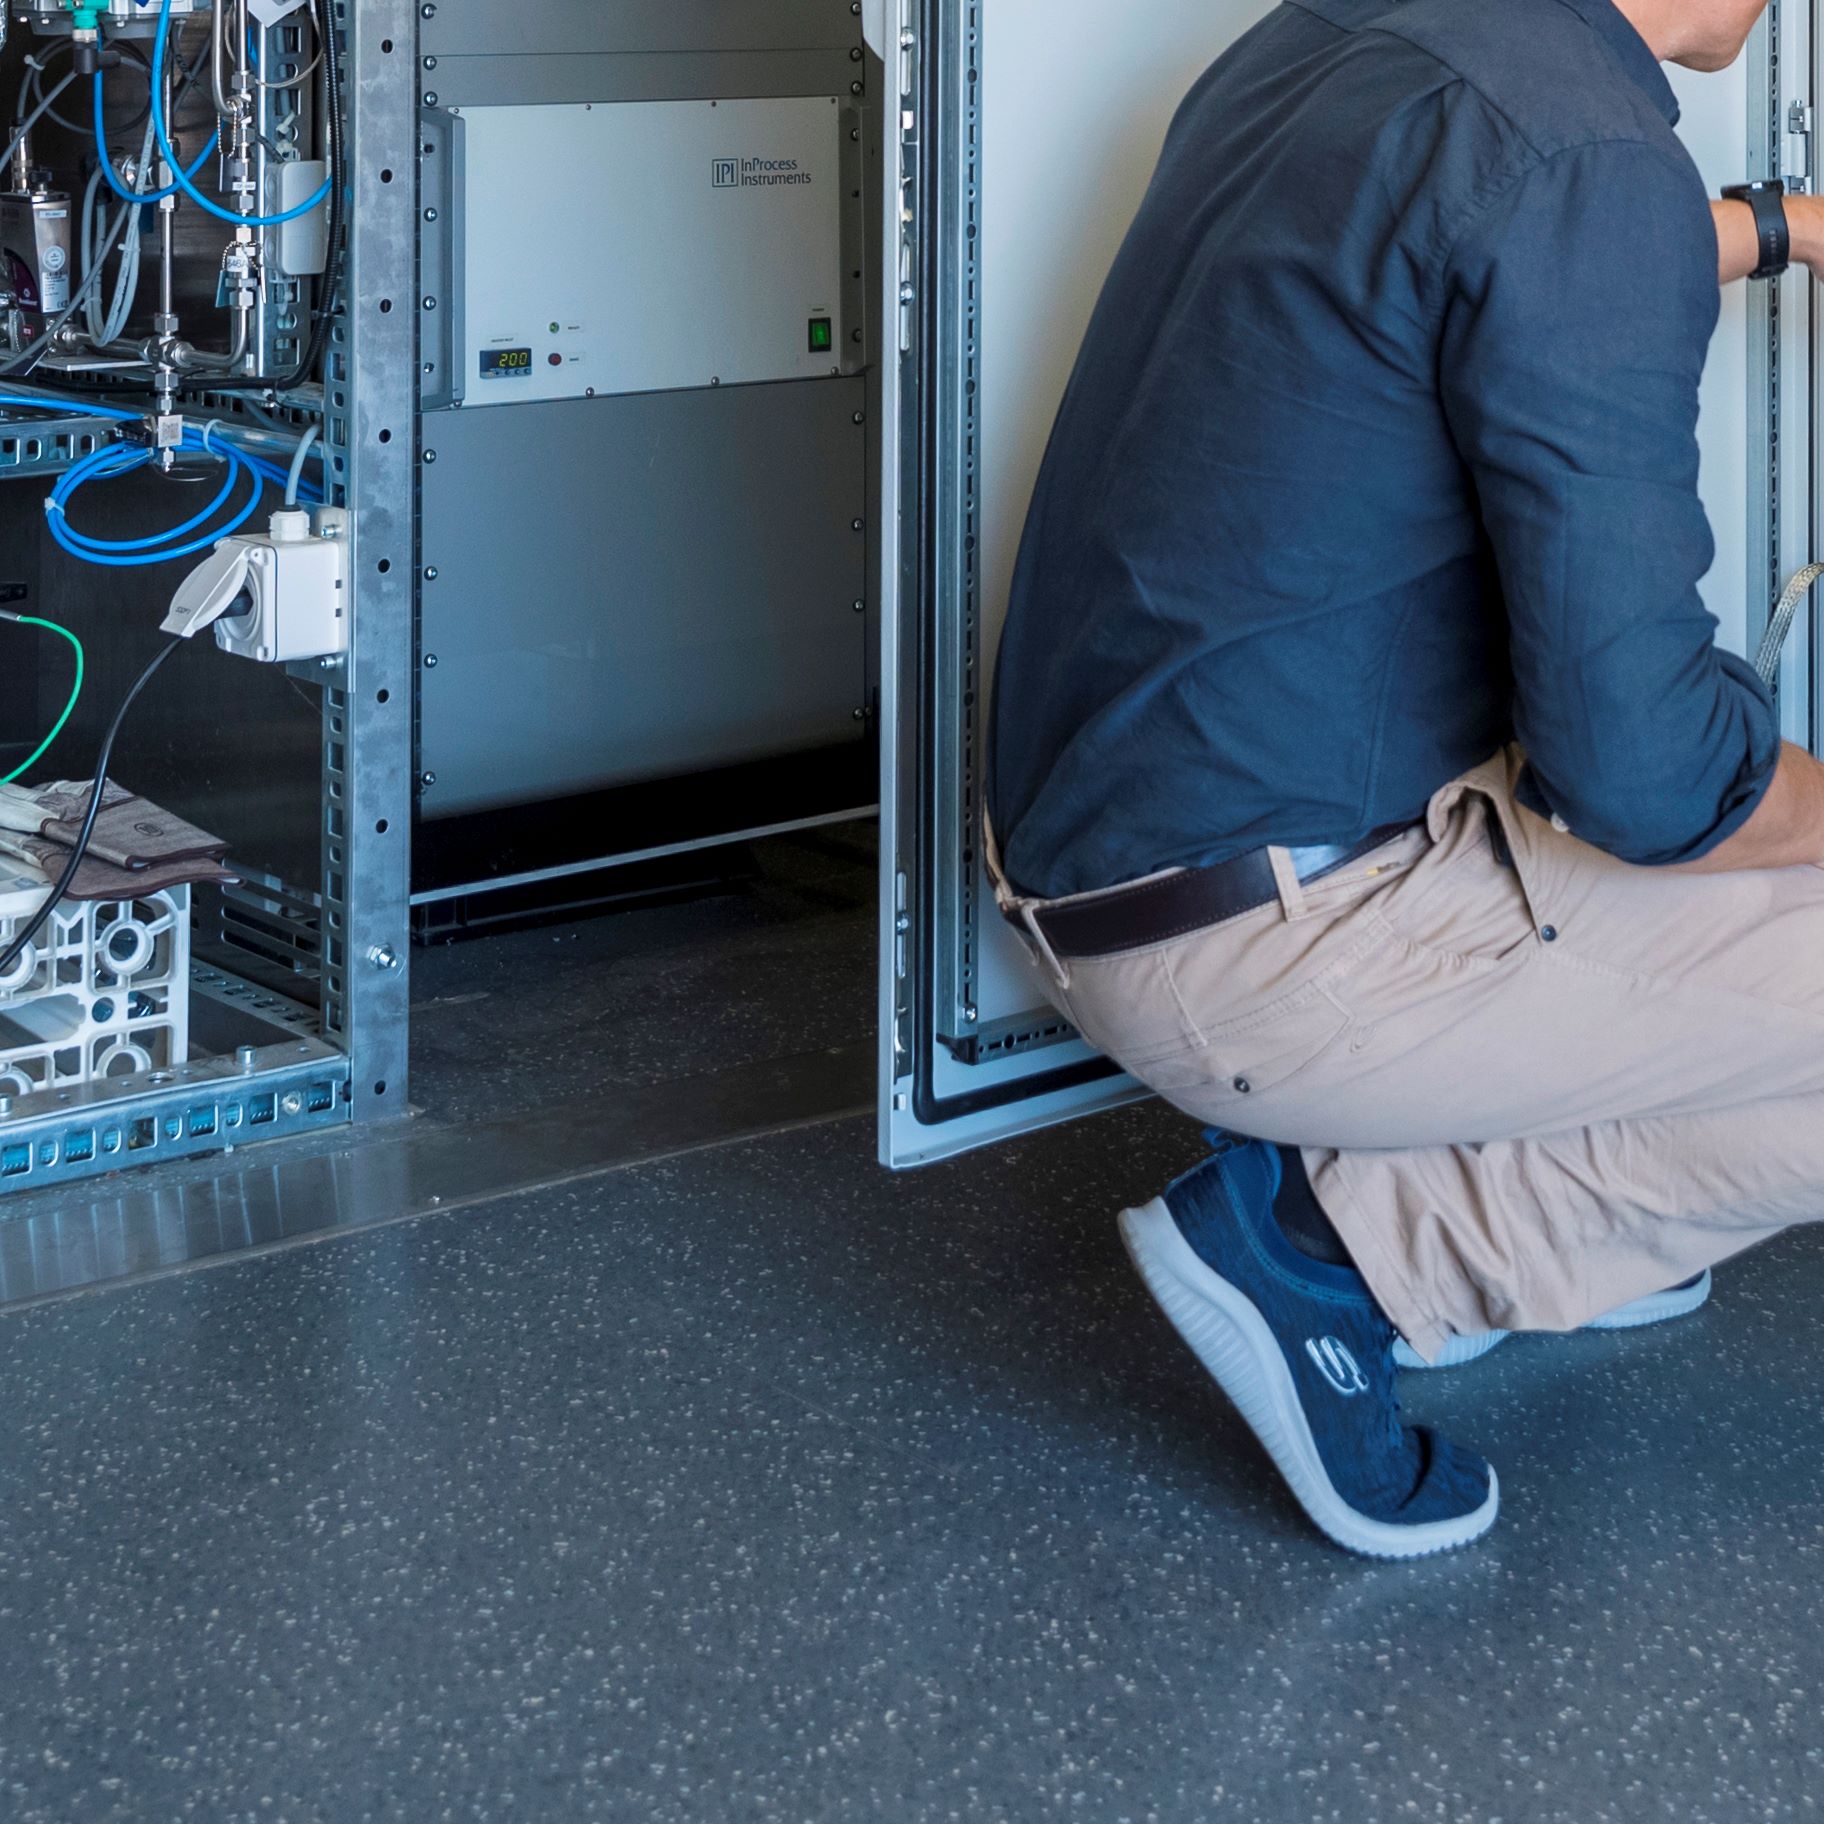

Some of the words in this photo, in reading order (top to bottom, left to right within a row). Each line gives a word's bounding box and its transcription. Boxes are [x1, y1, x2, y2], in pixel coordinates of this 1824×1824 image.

[716, 162, 734, 184] IPI
[741, 158, 798, 174] InProcess
[741, 172, 812, 186] Instruments
[498, 352, 528, 368] 200
